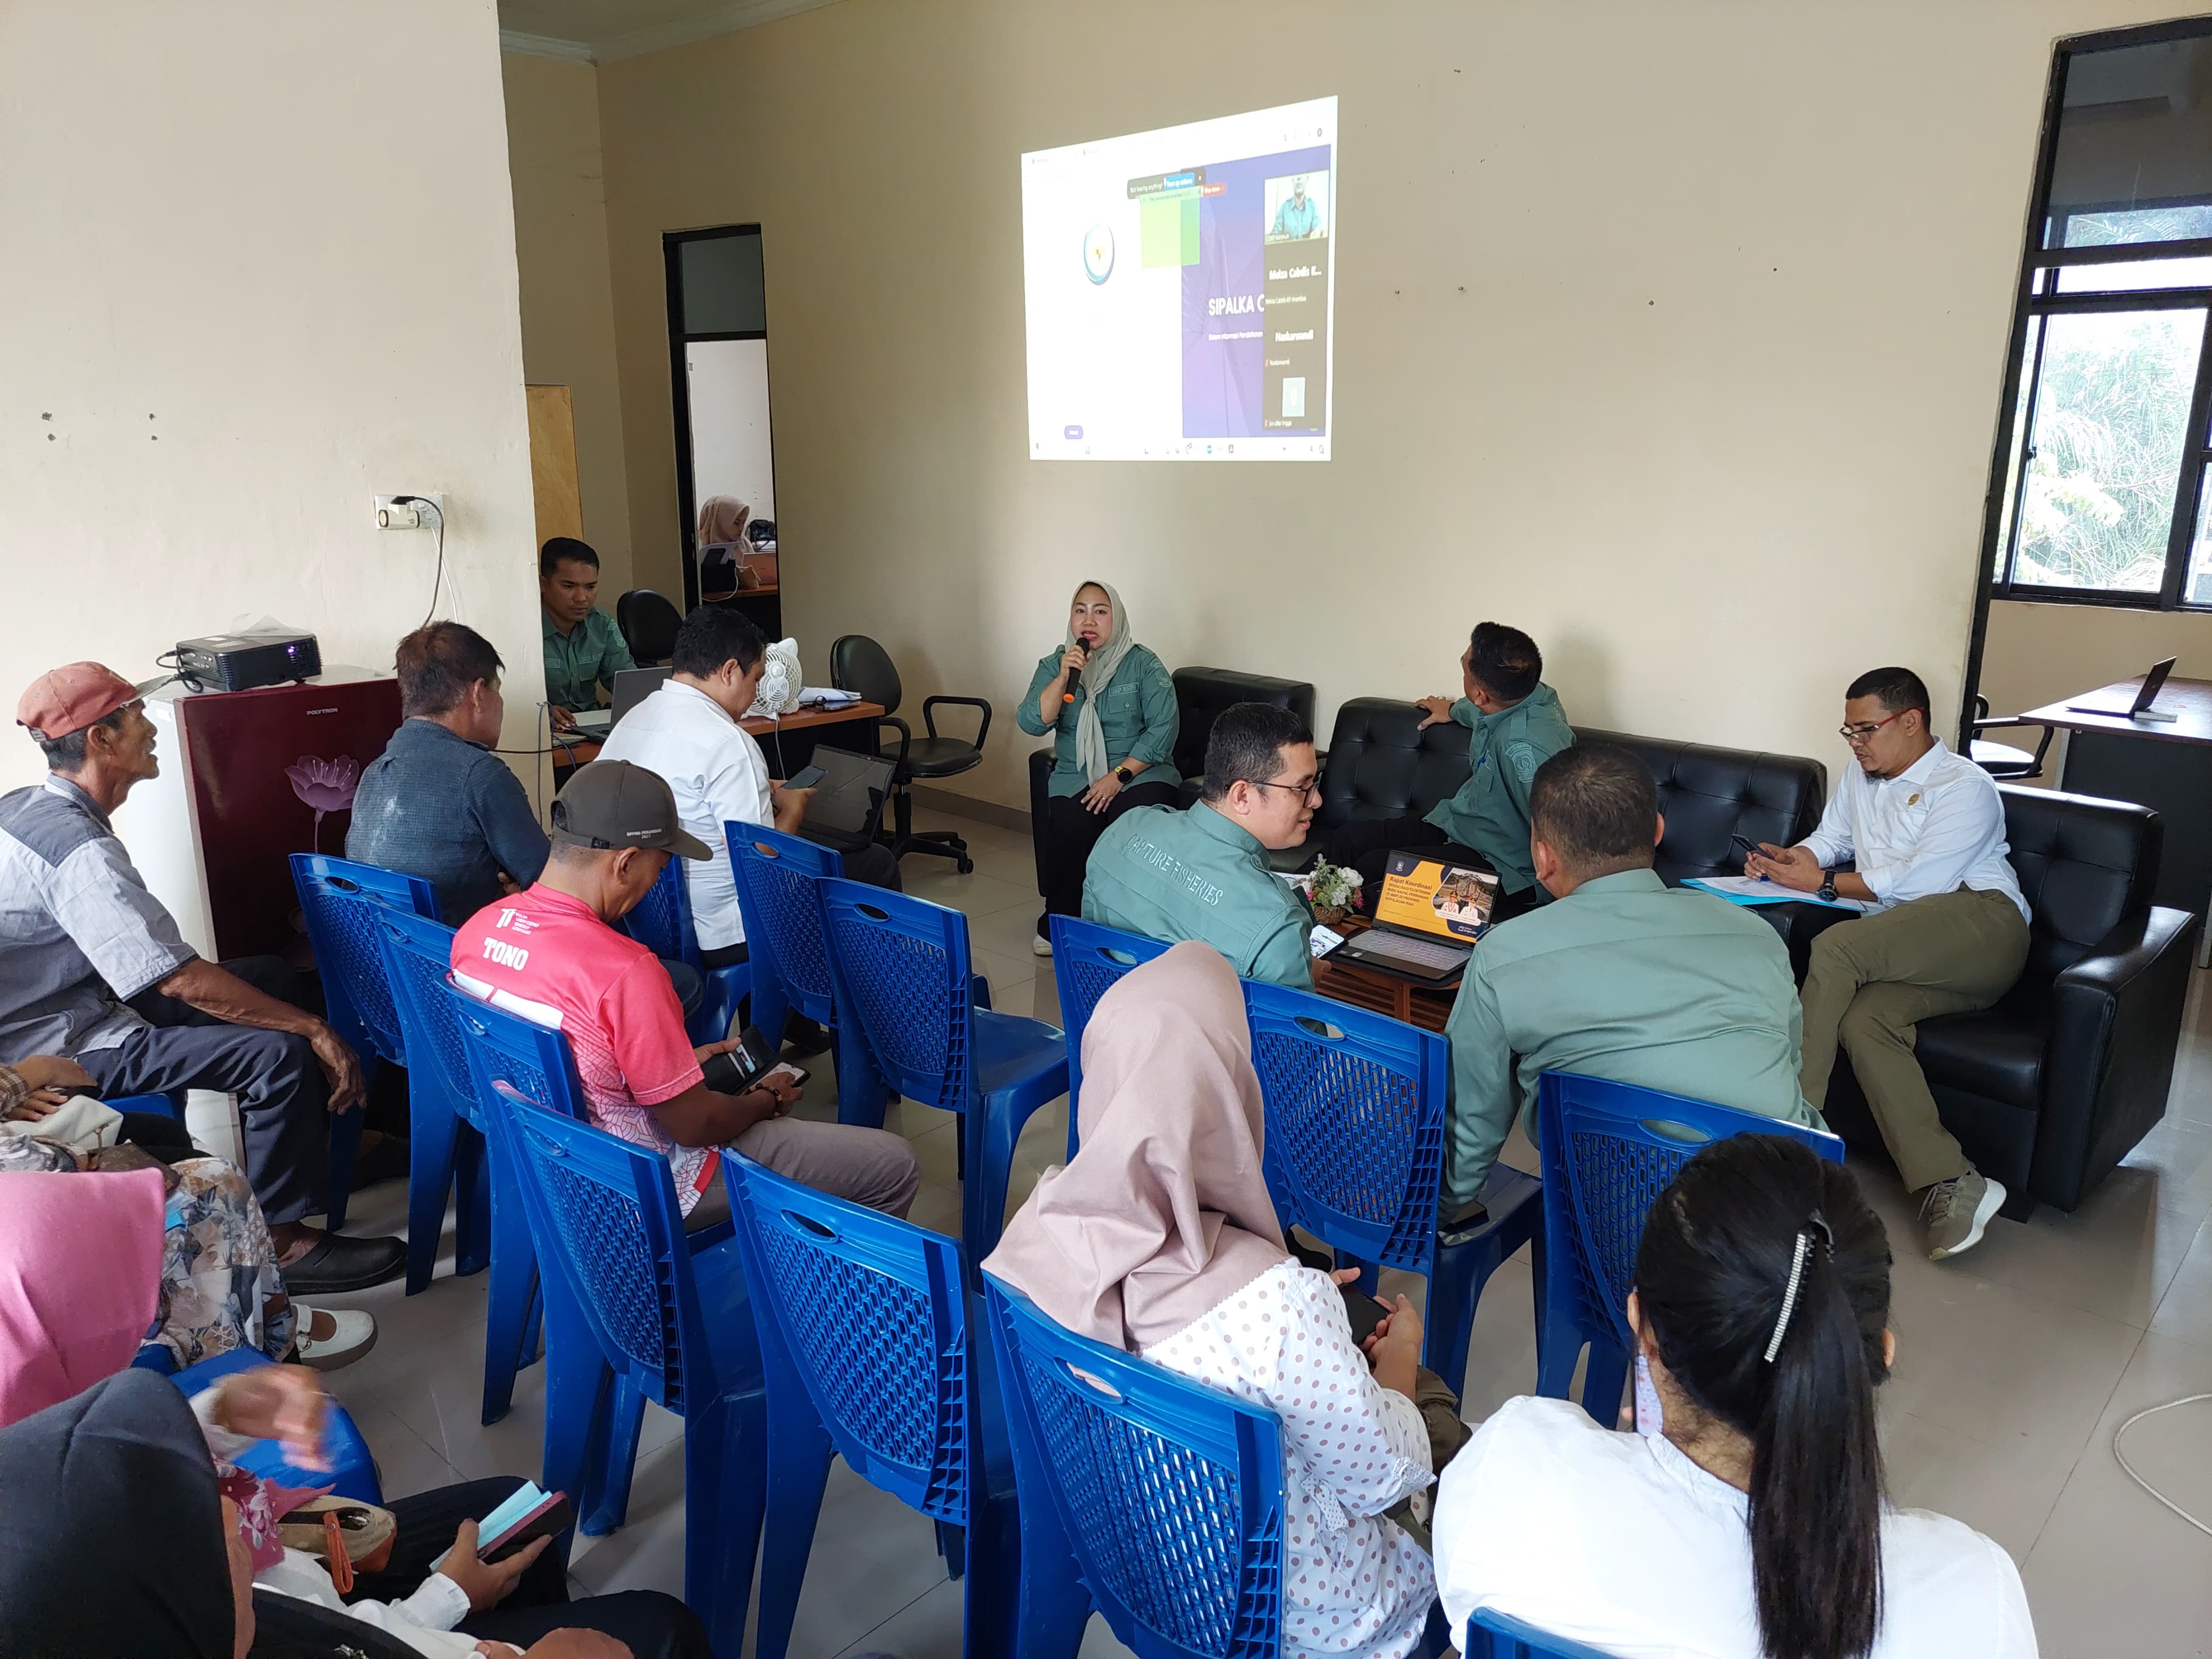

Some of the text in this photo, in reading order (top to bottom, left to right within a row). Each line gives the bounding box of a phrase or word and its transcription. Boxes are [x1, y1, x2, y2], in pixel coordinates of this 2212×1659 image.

[1209, 295, 1255, 316] SIPALKA
[306, 707, 338, 716] POLYTRON
[1127, 834, 1224, 906] CAPTURE FISHERIES
[1405, 879, 1432, 890] Koordinasi
[482, 936, 530, 971] TONO
